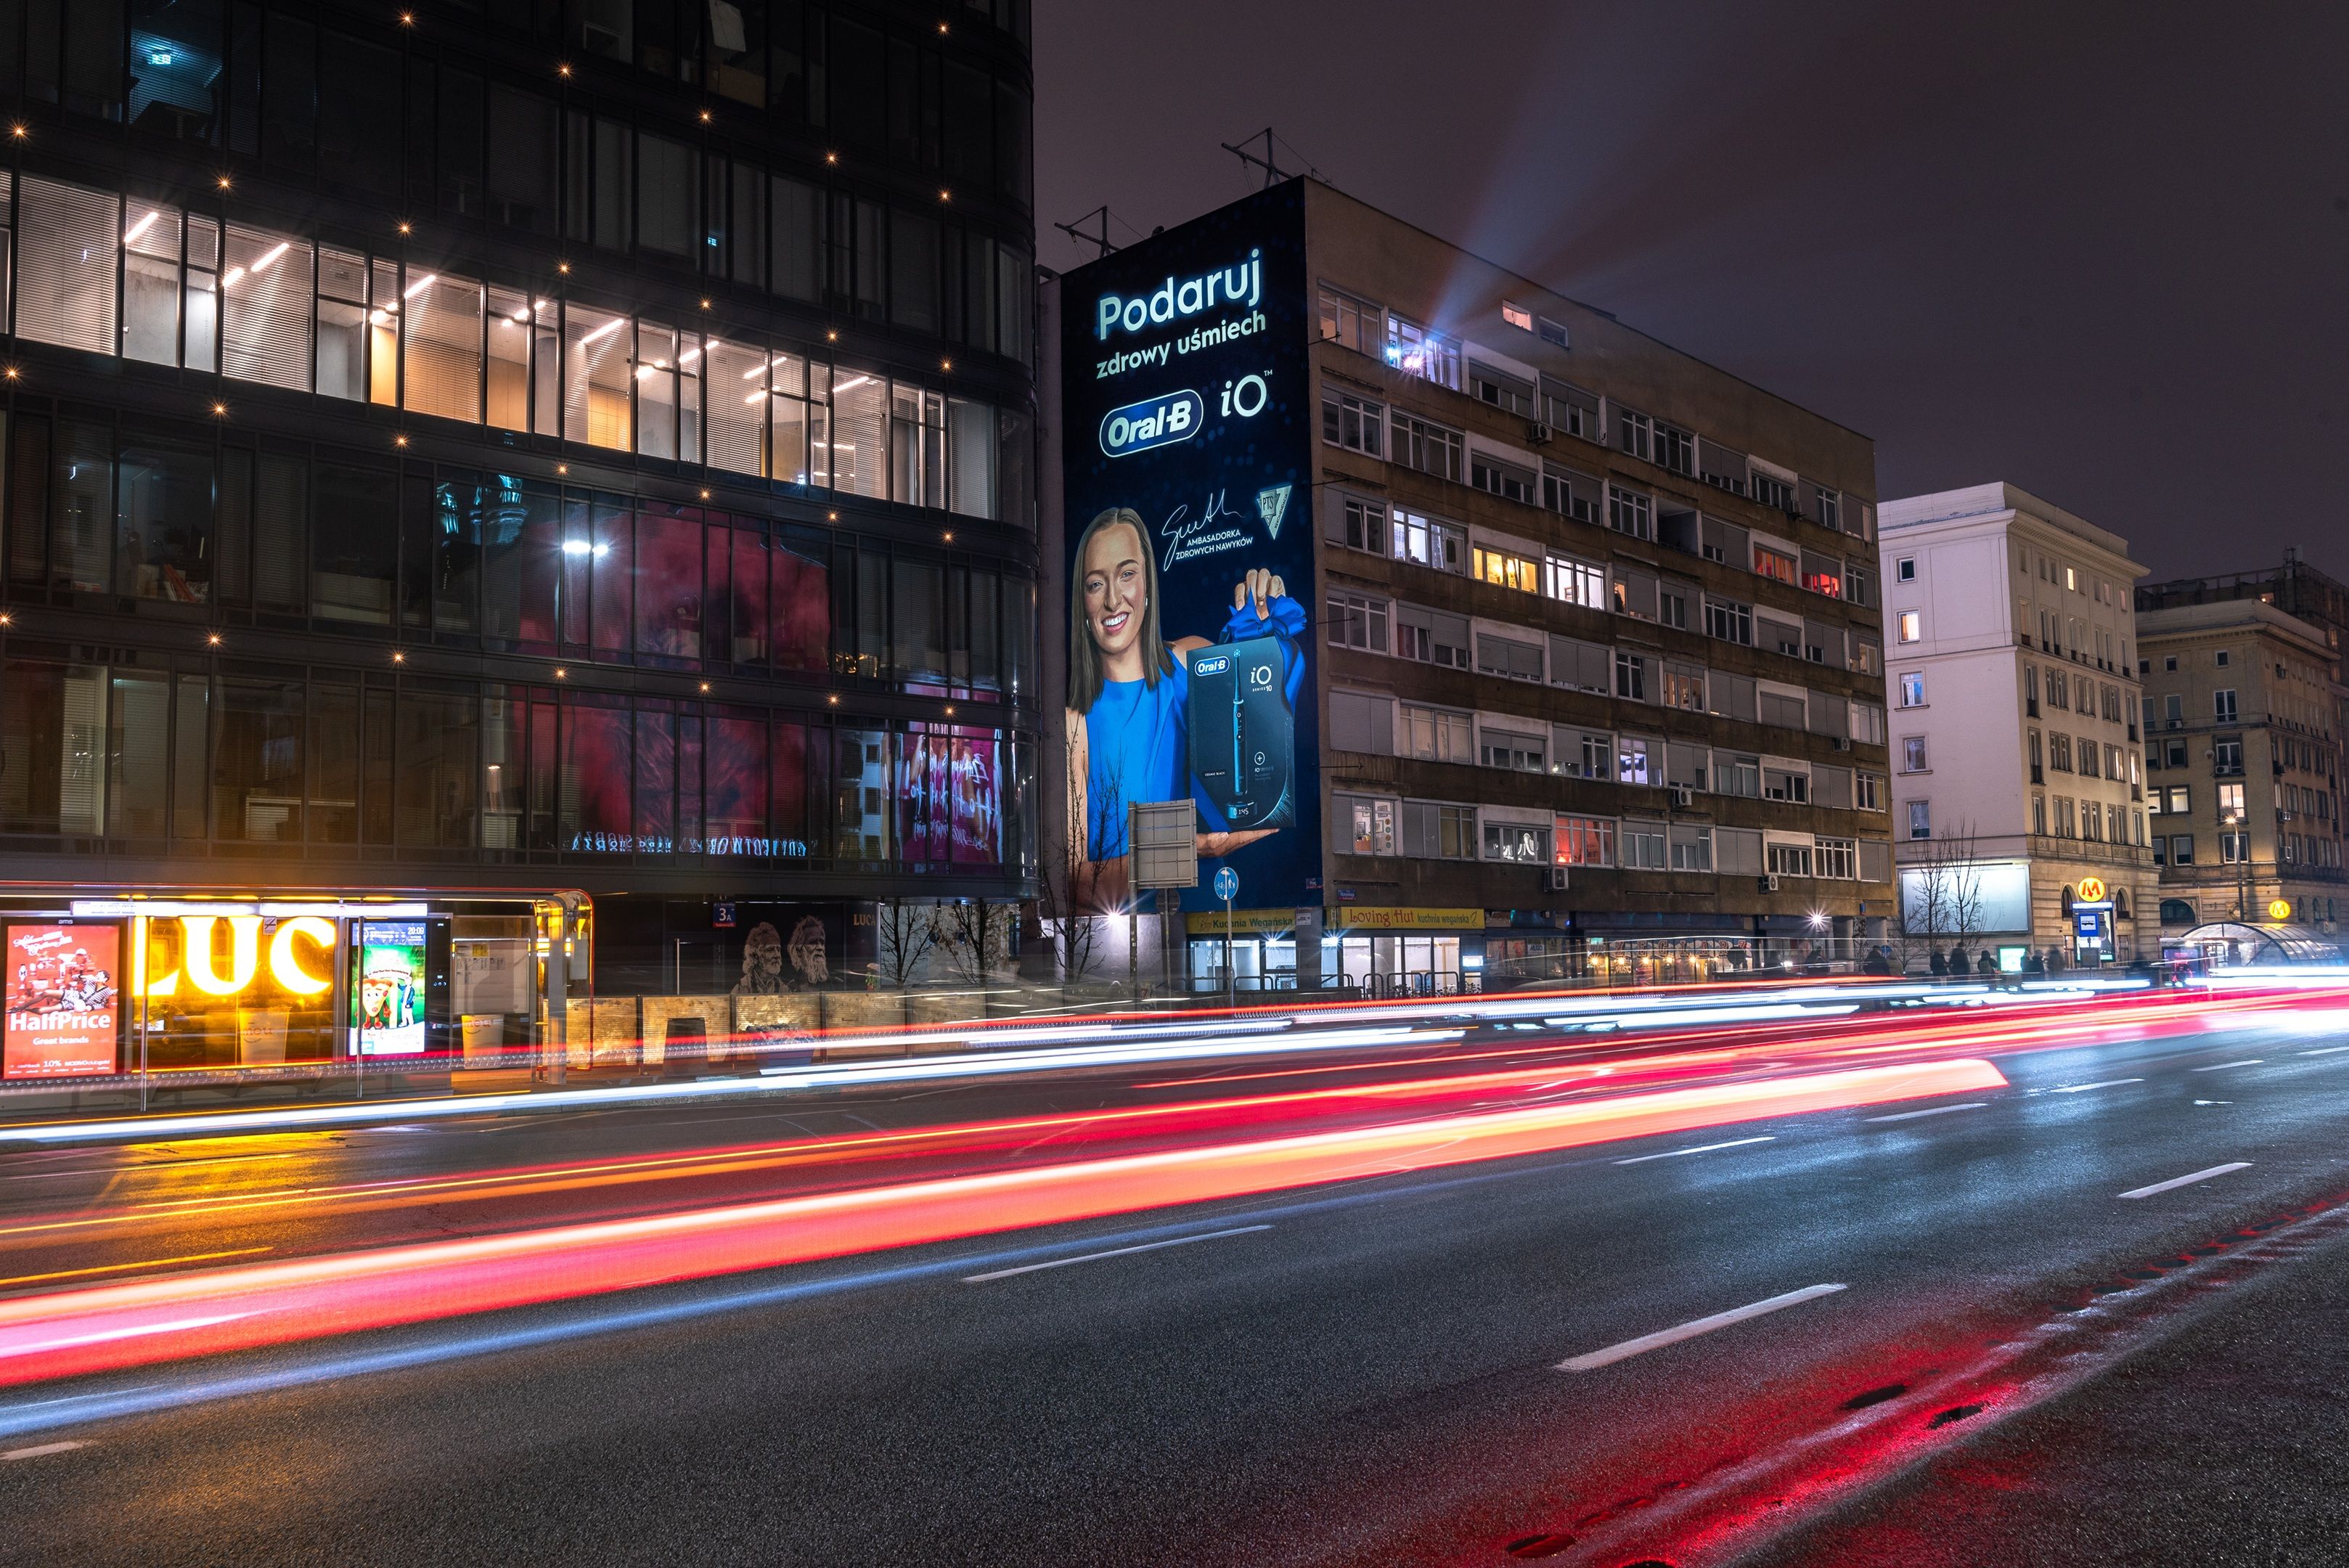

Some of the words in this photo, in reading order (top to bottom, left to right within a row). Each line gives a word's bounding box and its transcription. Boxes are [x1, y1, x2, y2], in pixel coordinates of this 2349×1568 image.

[1099, 248, 1260, 340] Podaruj
[1096, 342, 1171, 380] zdrowy
[1177, 309, 1266, 354] uśmiech
[1108, 400, 1192, 447] Oral-B
[1221, 374, 1267, 417] iO
[1263, 495, 1274, 510] PTS
[1274, 494, 1288, 529] REKOMENDACJA
[1186, 528, 1241, 547] AMBASADORKA
[1175, 544, 1214, 560] ZDROWYCH
[1215, 536, 1254, 552] NAWYKÓW
[1198, 660, 1226, 673] Oral-B
[1250, 666, 1272, 685] iO
[853, 914, 876, 926] LUCA
[1213, 919, 1246, 928] Kucnia
[1249, 917, 1293, 928] Wegańska
[1349, 909, 1391, 927] Loving
[1394, 909, 1415, 923] Hut
[1417, 912, 1440, 923] kuchnia
[1441, 914, 1470, 926] wegańska
[407, 926, 424, 935] 20:09
[10, 1011, 111, 1031] HalfPrice
[33, 1037, 58, 1045] Great
[60, 1036, 89, 1045] brands
